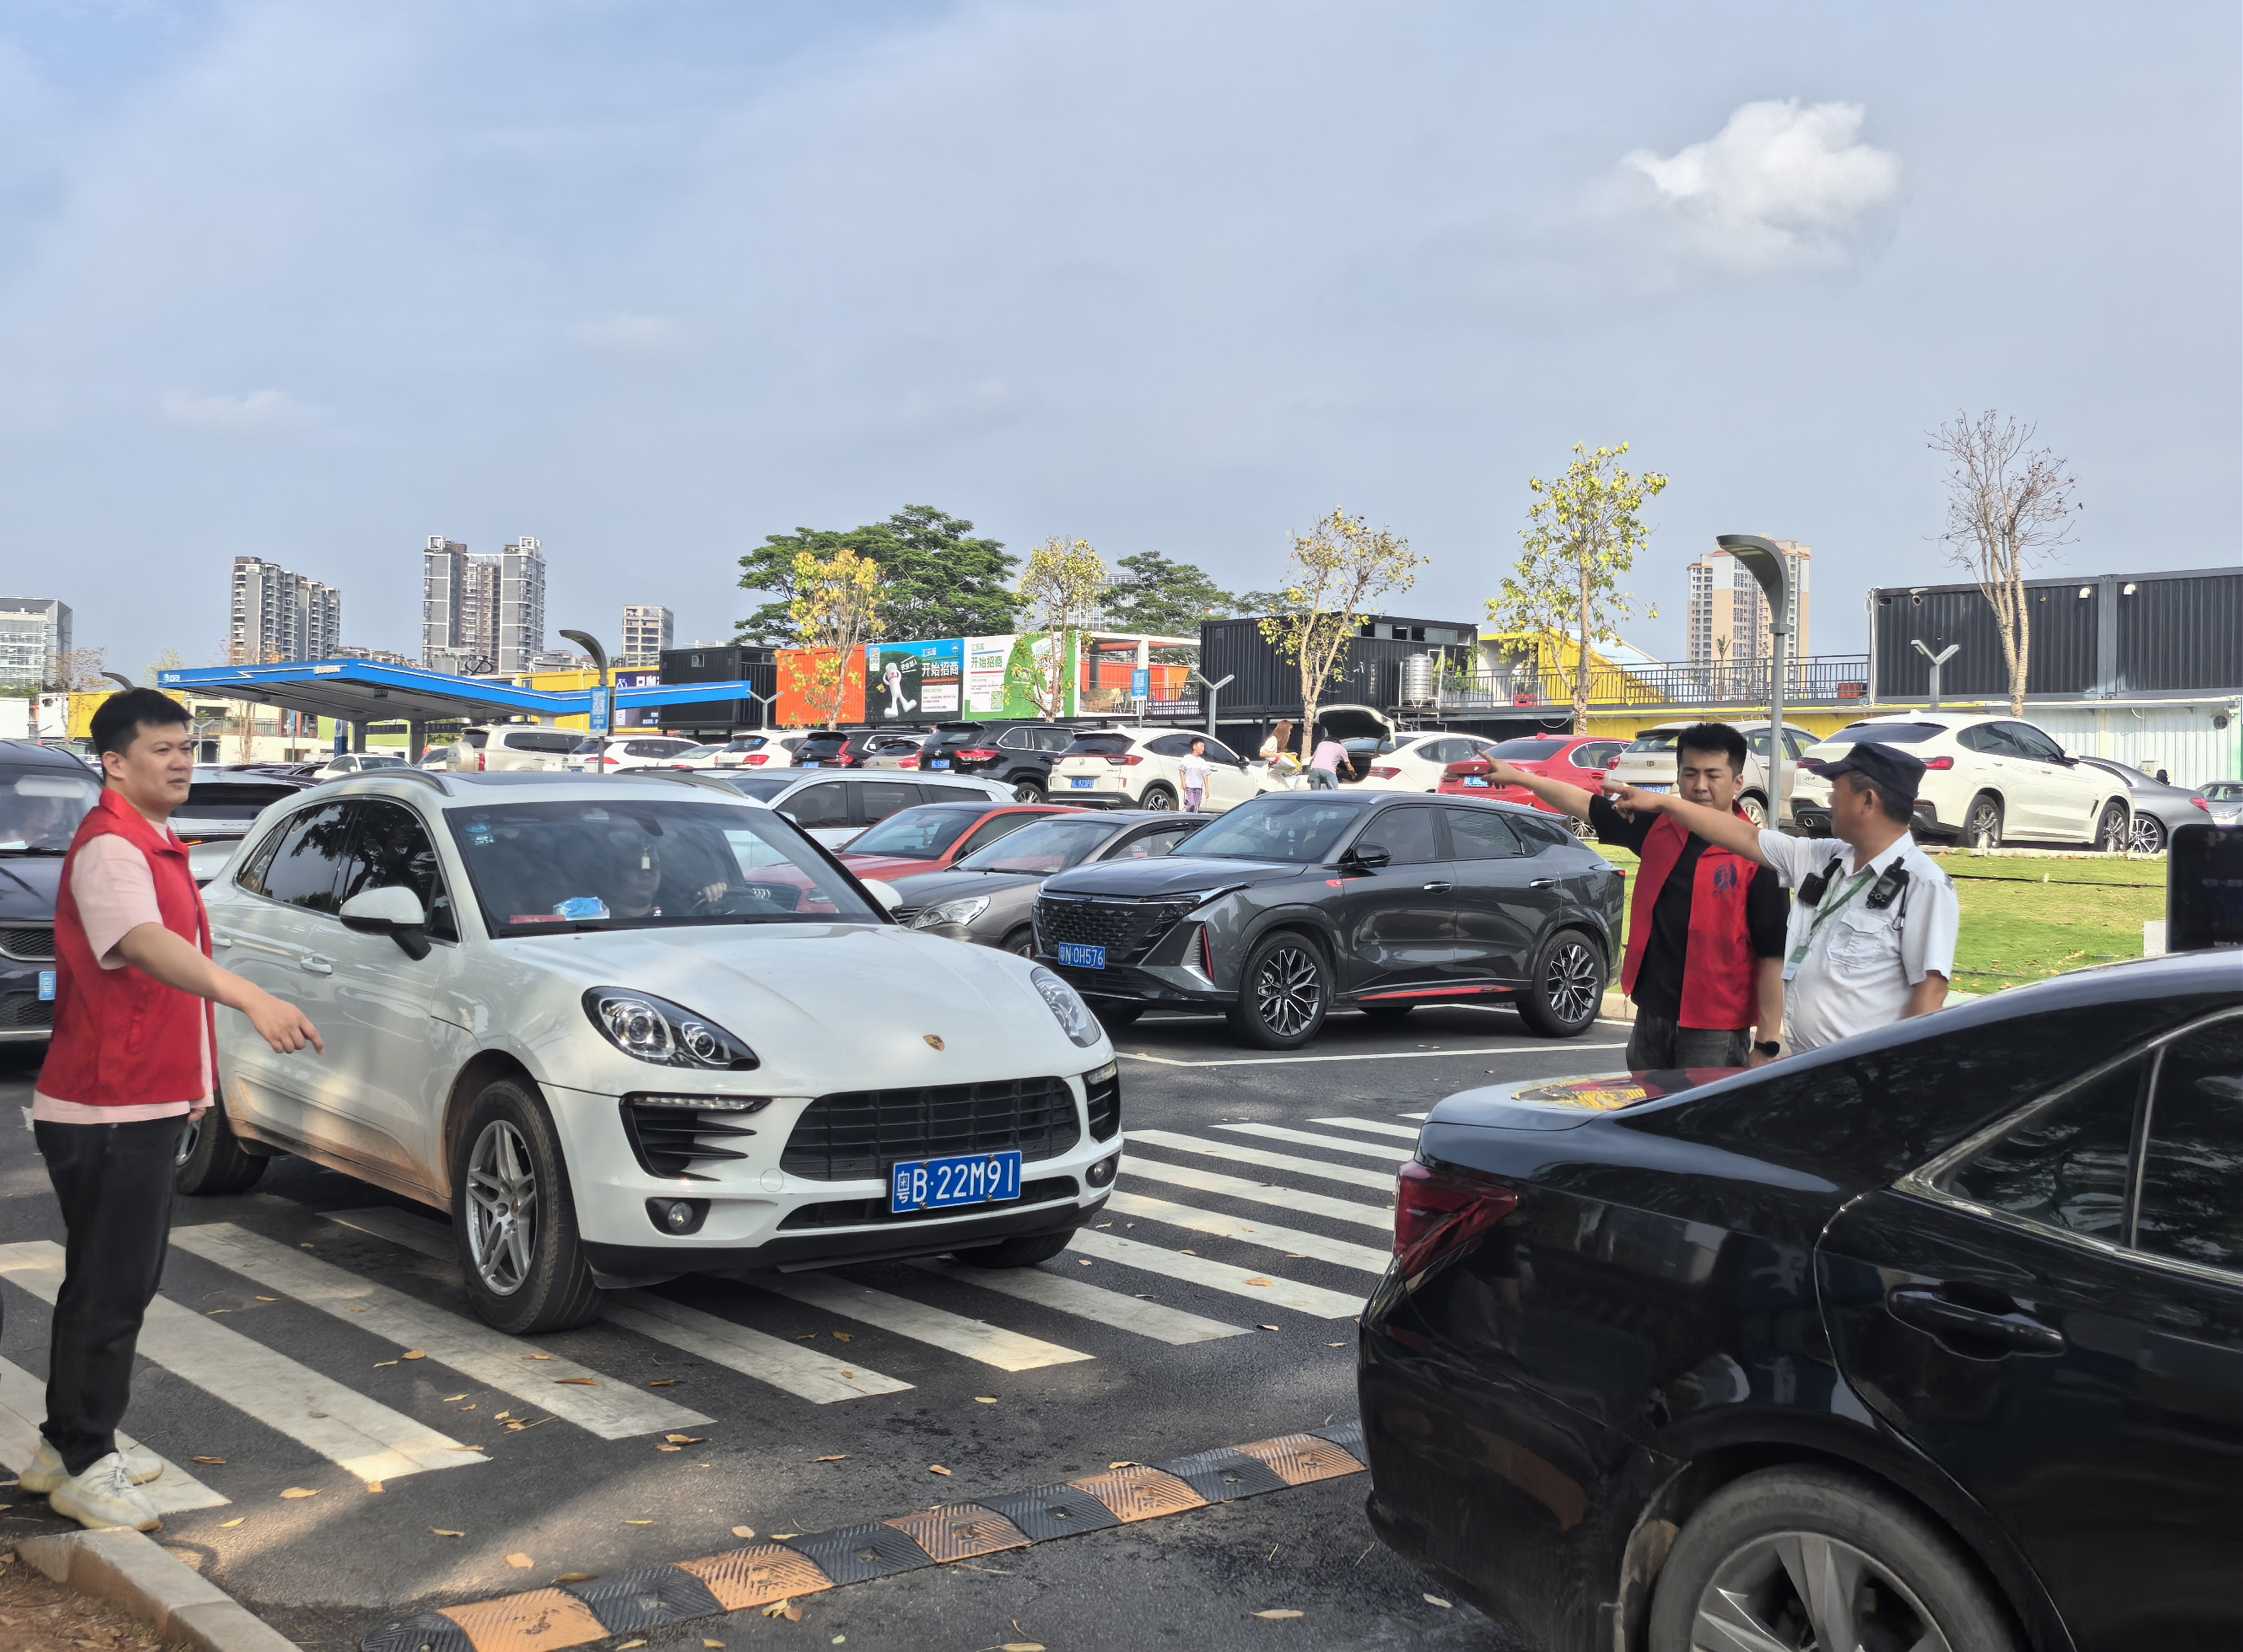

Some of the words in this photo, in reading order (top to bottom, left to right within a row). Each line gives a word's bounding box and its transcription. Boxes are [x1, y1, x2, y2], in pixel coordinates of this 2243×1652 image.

[922, 661, 959, 677] 开始招商
[971, 656, 1003, 668] 开始招商
[896, 1158, 1014, 1204] 粤B·22M91
